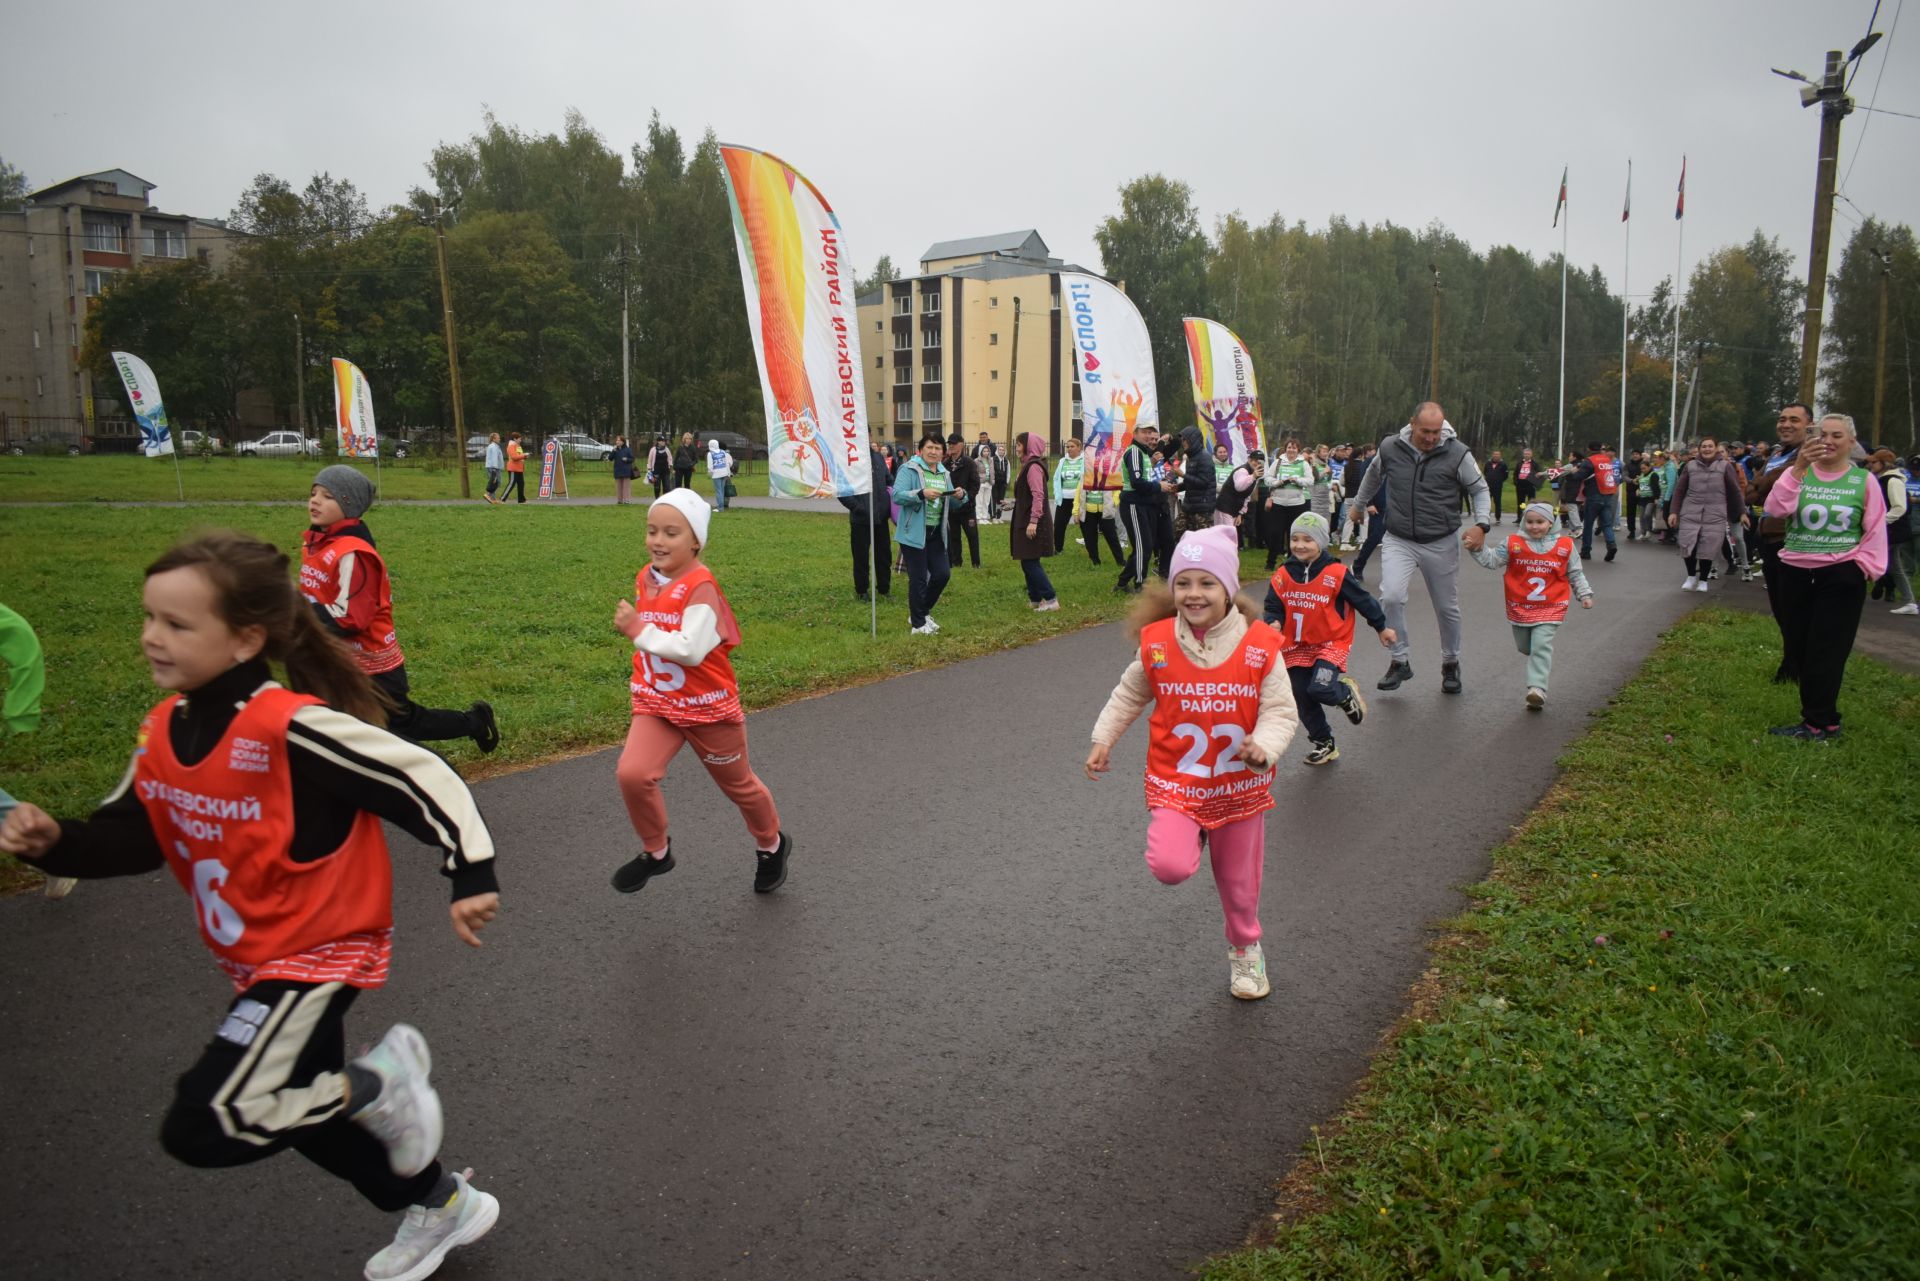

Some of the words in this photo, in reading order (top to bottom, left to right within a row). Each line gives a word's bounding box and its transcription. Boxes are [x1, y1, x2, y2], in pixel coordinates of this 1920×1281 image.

[819, 229, 842, 305] РАЙОН
[1071, 283, 1097, 351] СПОРТ!
[1085, 372, 1102, 384] Я
[1233, 346, 1245, 382] СПОРТА!
[830, 316, 860, 466] ТУКАЕВСКИЙ
[540, 441, 555, 497] ФИНИШ
[1526, 564, 1552, 574] РАЙОН
[1527, 577, 1547, 601] 2
[1287, 598, 1315, 610] РАЙОН
[1292, 612, 1304, 642] 1
[1158, 682, 1257, 699] ТУКАЕВСКИЙ
[1181, 696, 1236, 712] РАЙОН
[1171, 722, 1248, 779] 22
[1186, 783, 1232, 799] НОРМА
[1232, 772, 1273, 793] ЖИЗНИ
